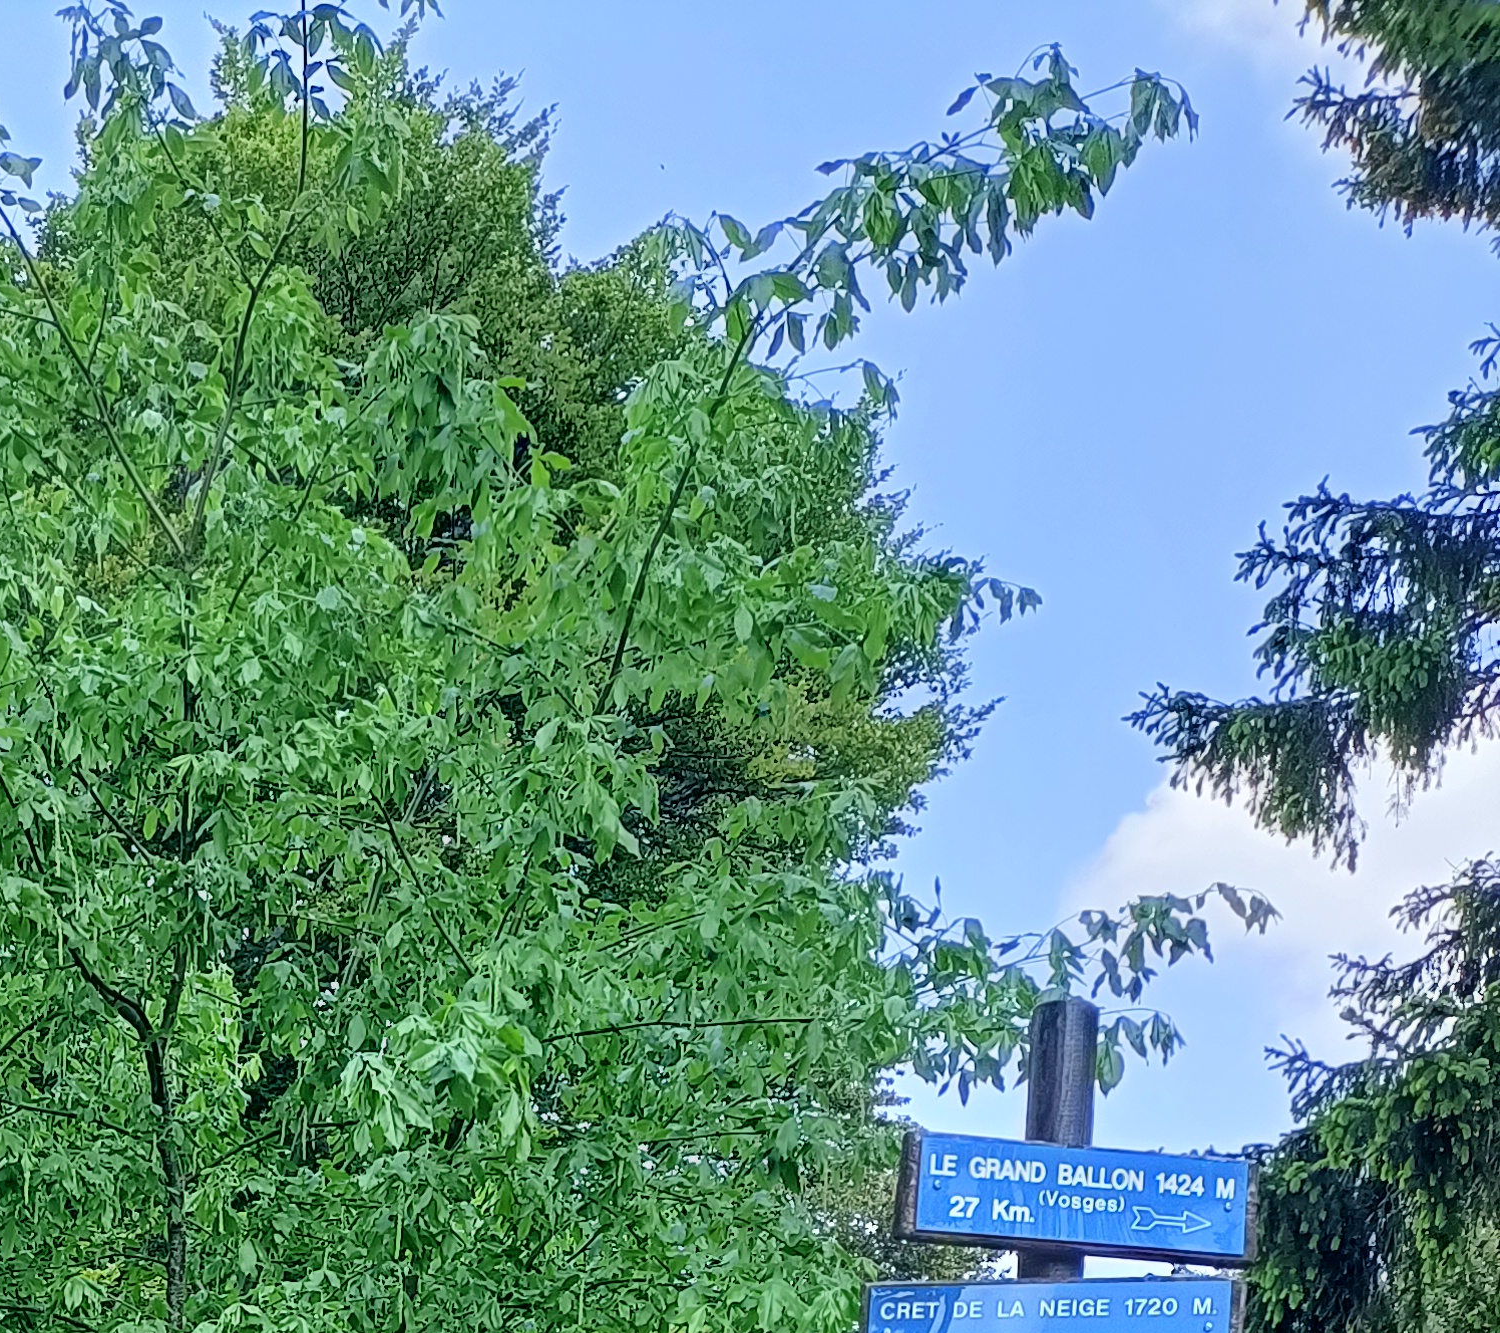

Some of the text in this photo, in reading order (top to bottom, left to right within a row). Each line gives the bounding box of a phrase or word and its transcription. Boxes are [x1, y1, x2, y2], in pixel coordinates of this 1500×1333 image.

[929, 1153, 1235, 1199] LE GRAND BALLON 1424 M
[948, 1190, 1125, 1223] 27 Km. (Vosges)
[880, 1297, 1217, 1320] CRET DE LA NEIGE 1720 M.
